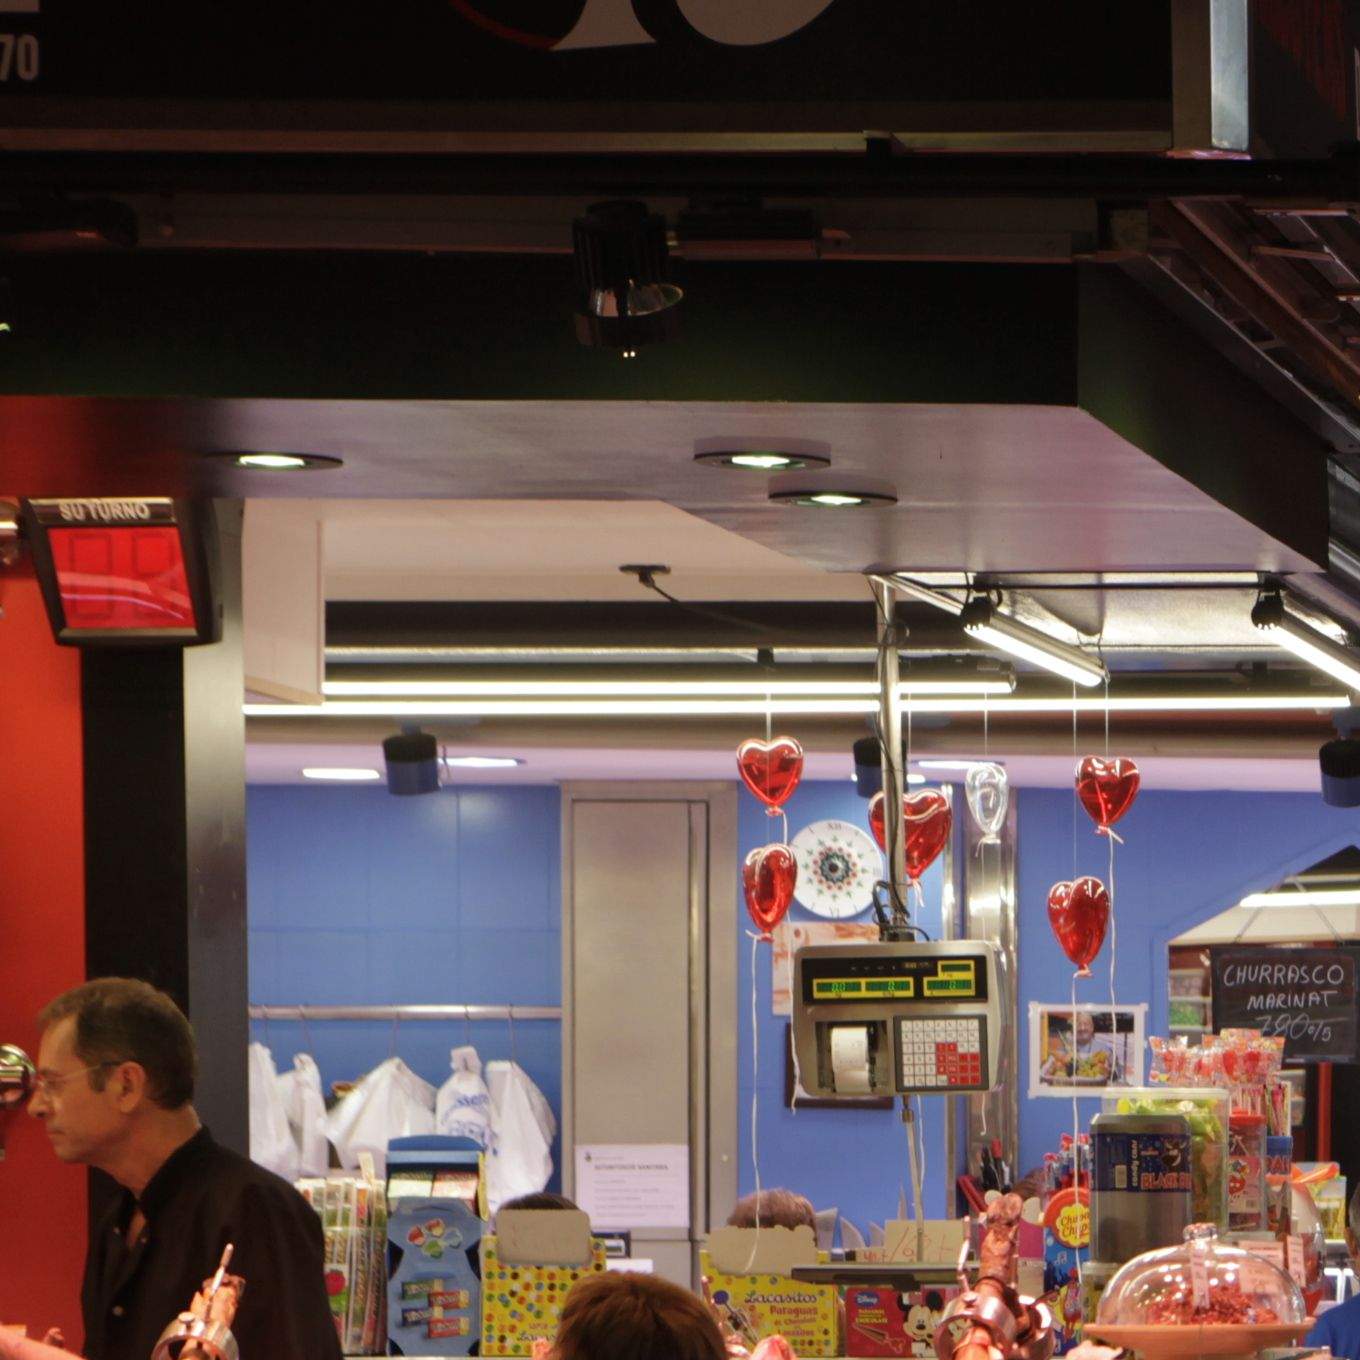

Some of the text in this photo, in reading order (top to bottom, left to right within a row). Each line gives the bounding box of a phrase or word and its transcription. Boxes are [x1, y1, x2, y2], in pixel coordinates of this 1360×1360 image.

[87, 502, 151, 523] TURNO
[1223, 963, 1345, 987] CHURRASCO
[744, 1290, 817, 1304] Lacasitos
